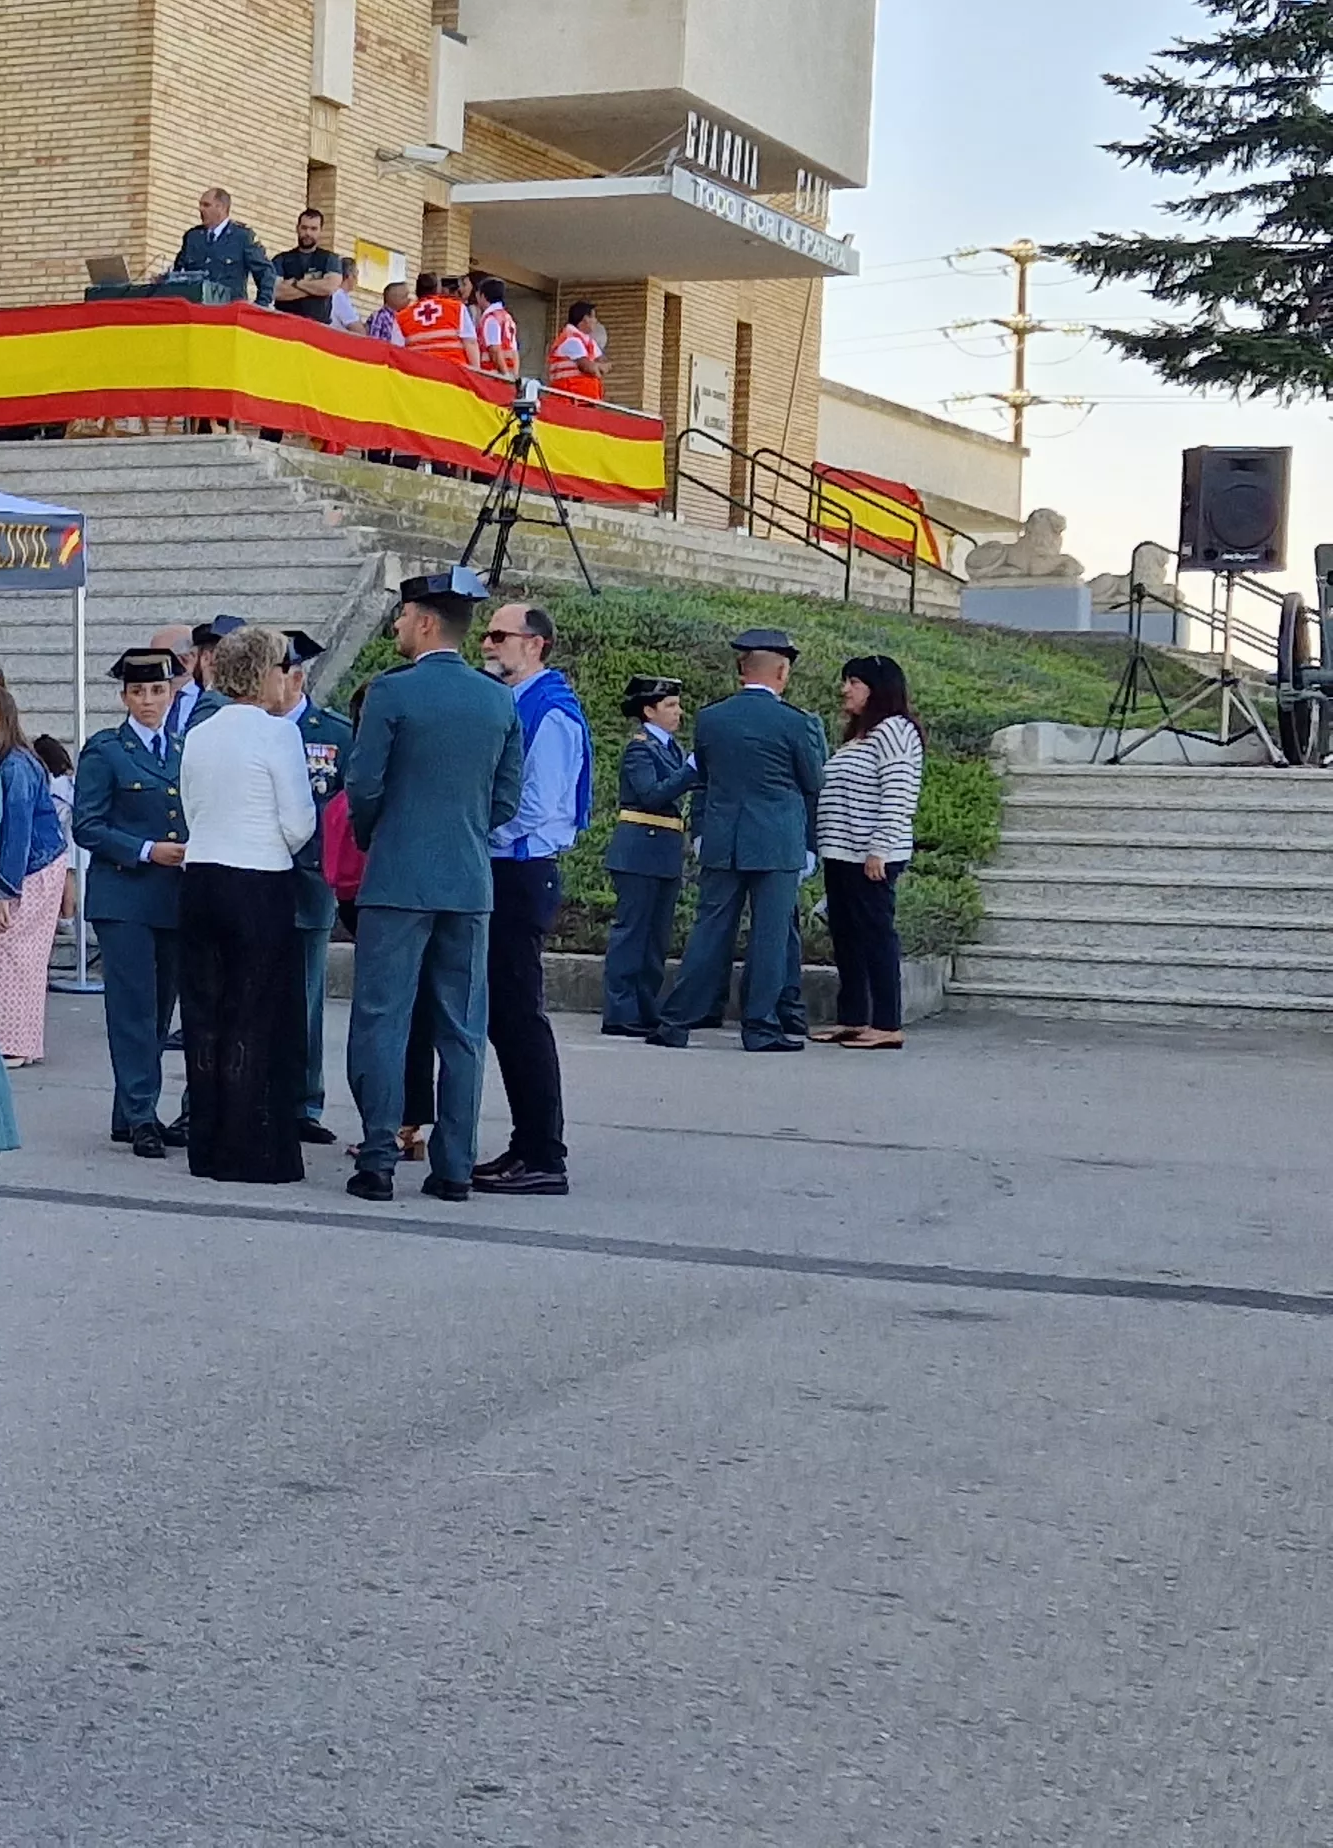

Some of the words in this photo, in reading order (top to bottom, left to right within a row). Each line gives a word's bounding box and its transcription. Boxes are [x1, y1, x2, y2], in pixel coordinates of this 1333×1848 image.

[685, 110, 758, 190] GUARDIA
[795, 168, 833, 222] CIVI
[697, 177, 737, 218] TODO
